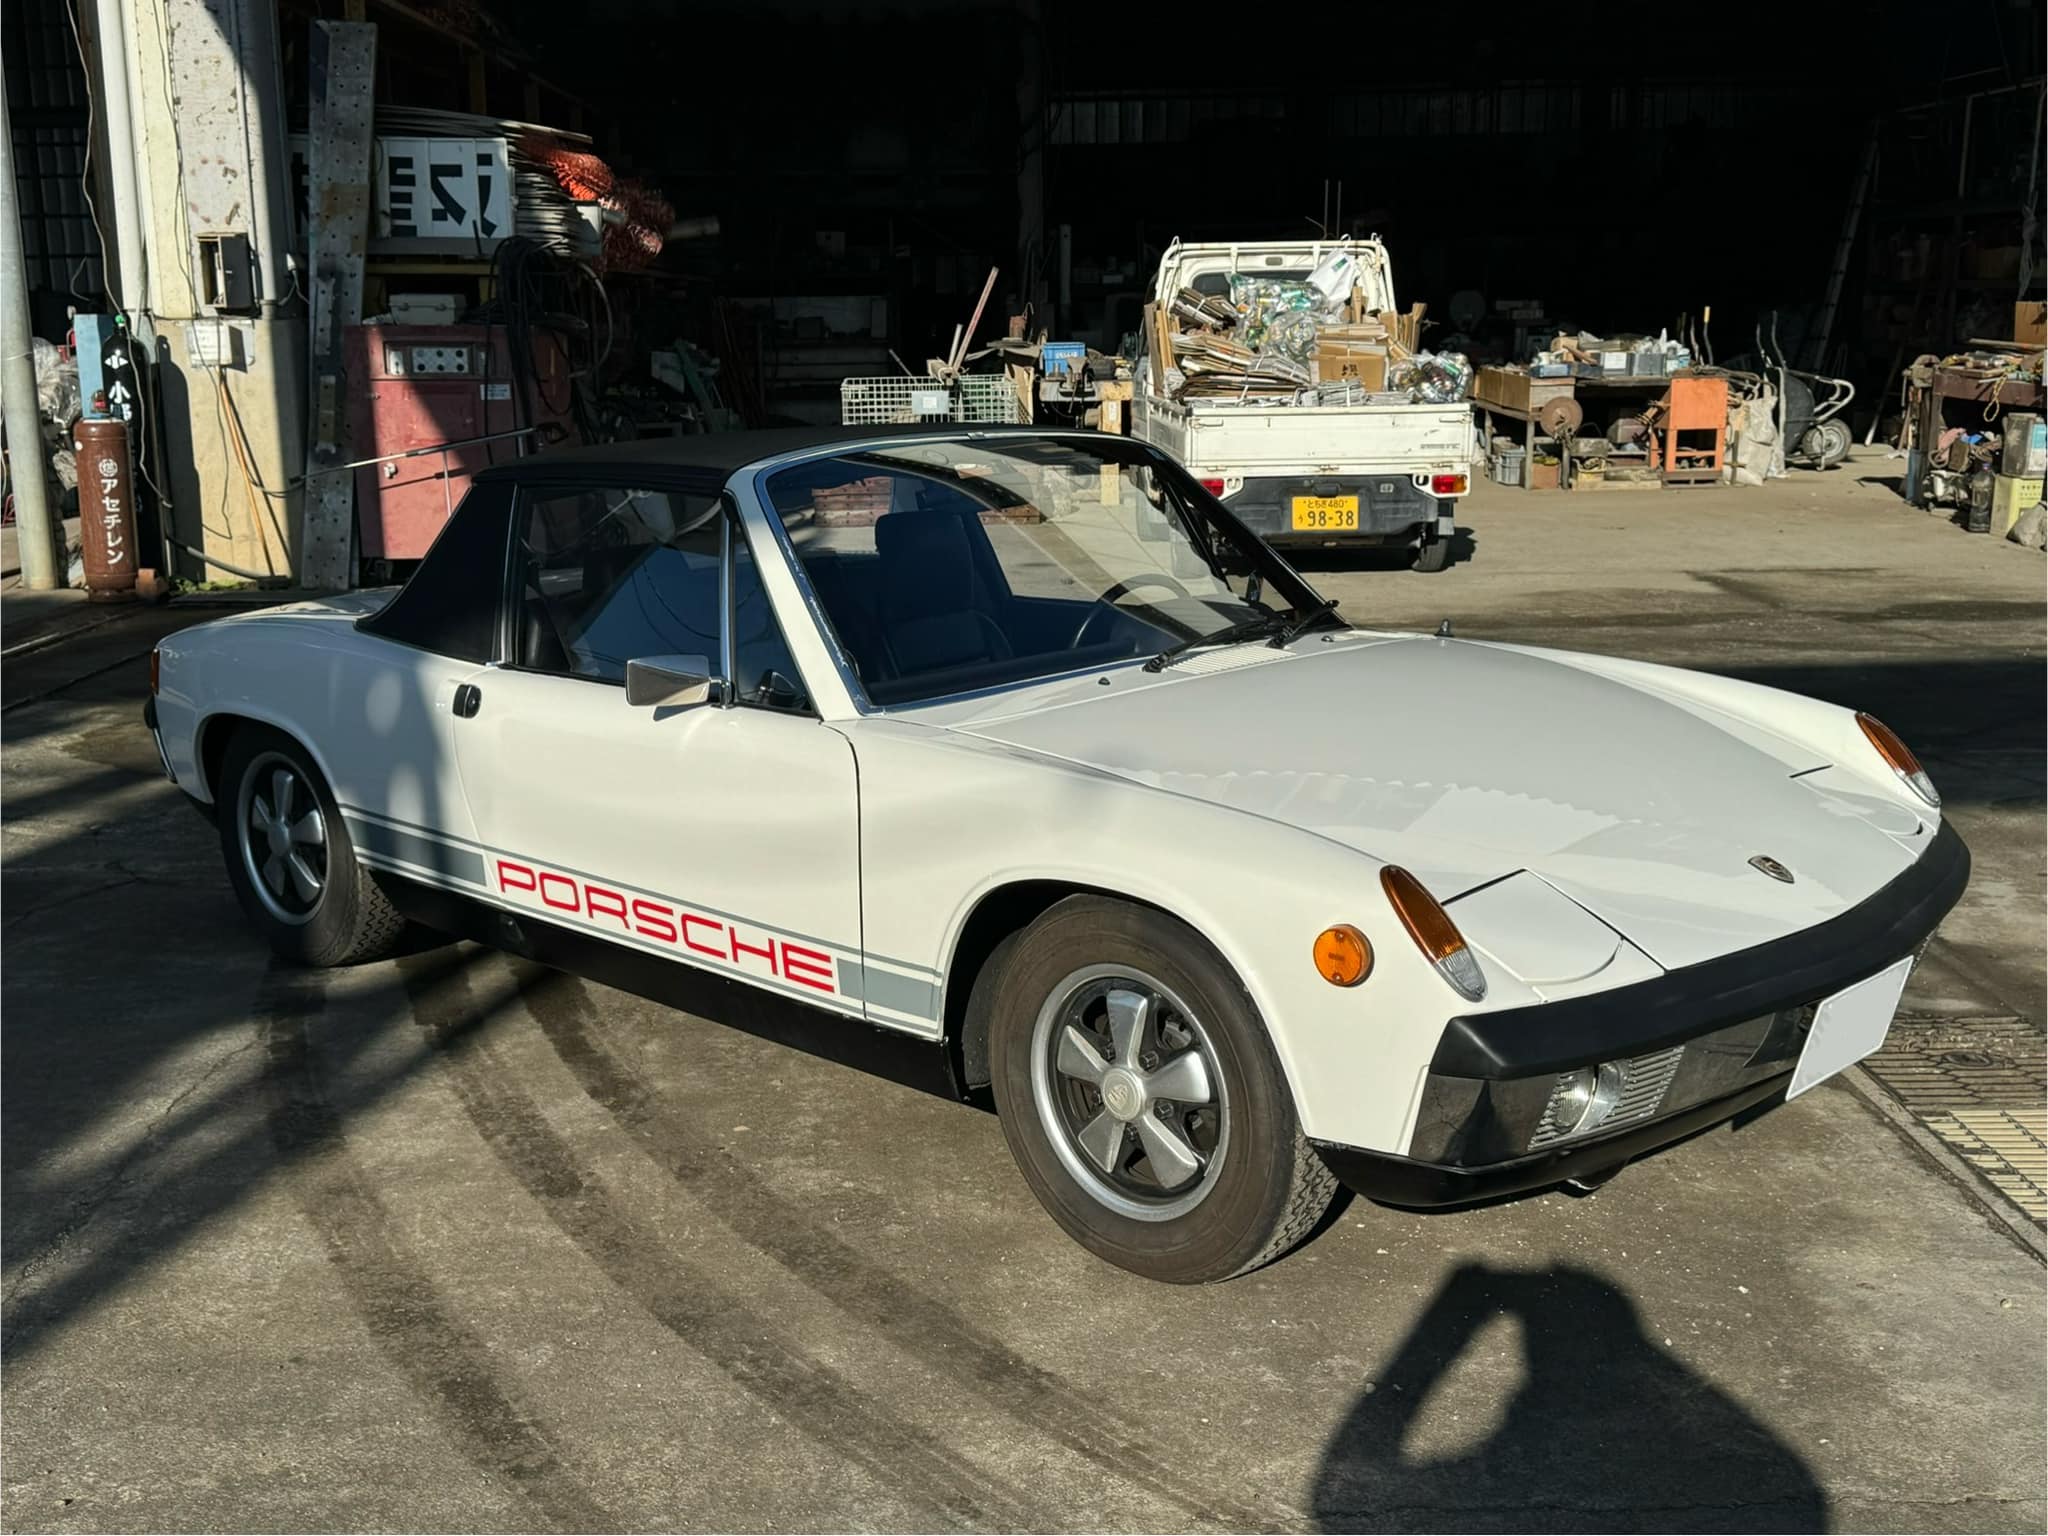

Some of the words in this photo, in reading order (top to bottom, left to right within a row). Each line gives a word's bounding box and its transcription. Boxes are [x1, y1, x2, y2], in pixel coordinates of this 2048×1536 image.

[100, 478, 124, 565] アセチレン
[1307, 510, 1354, 527] 98-38
[496, 859, 836, 994] PORSCHE
